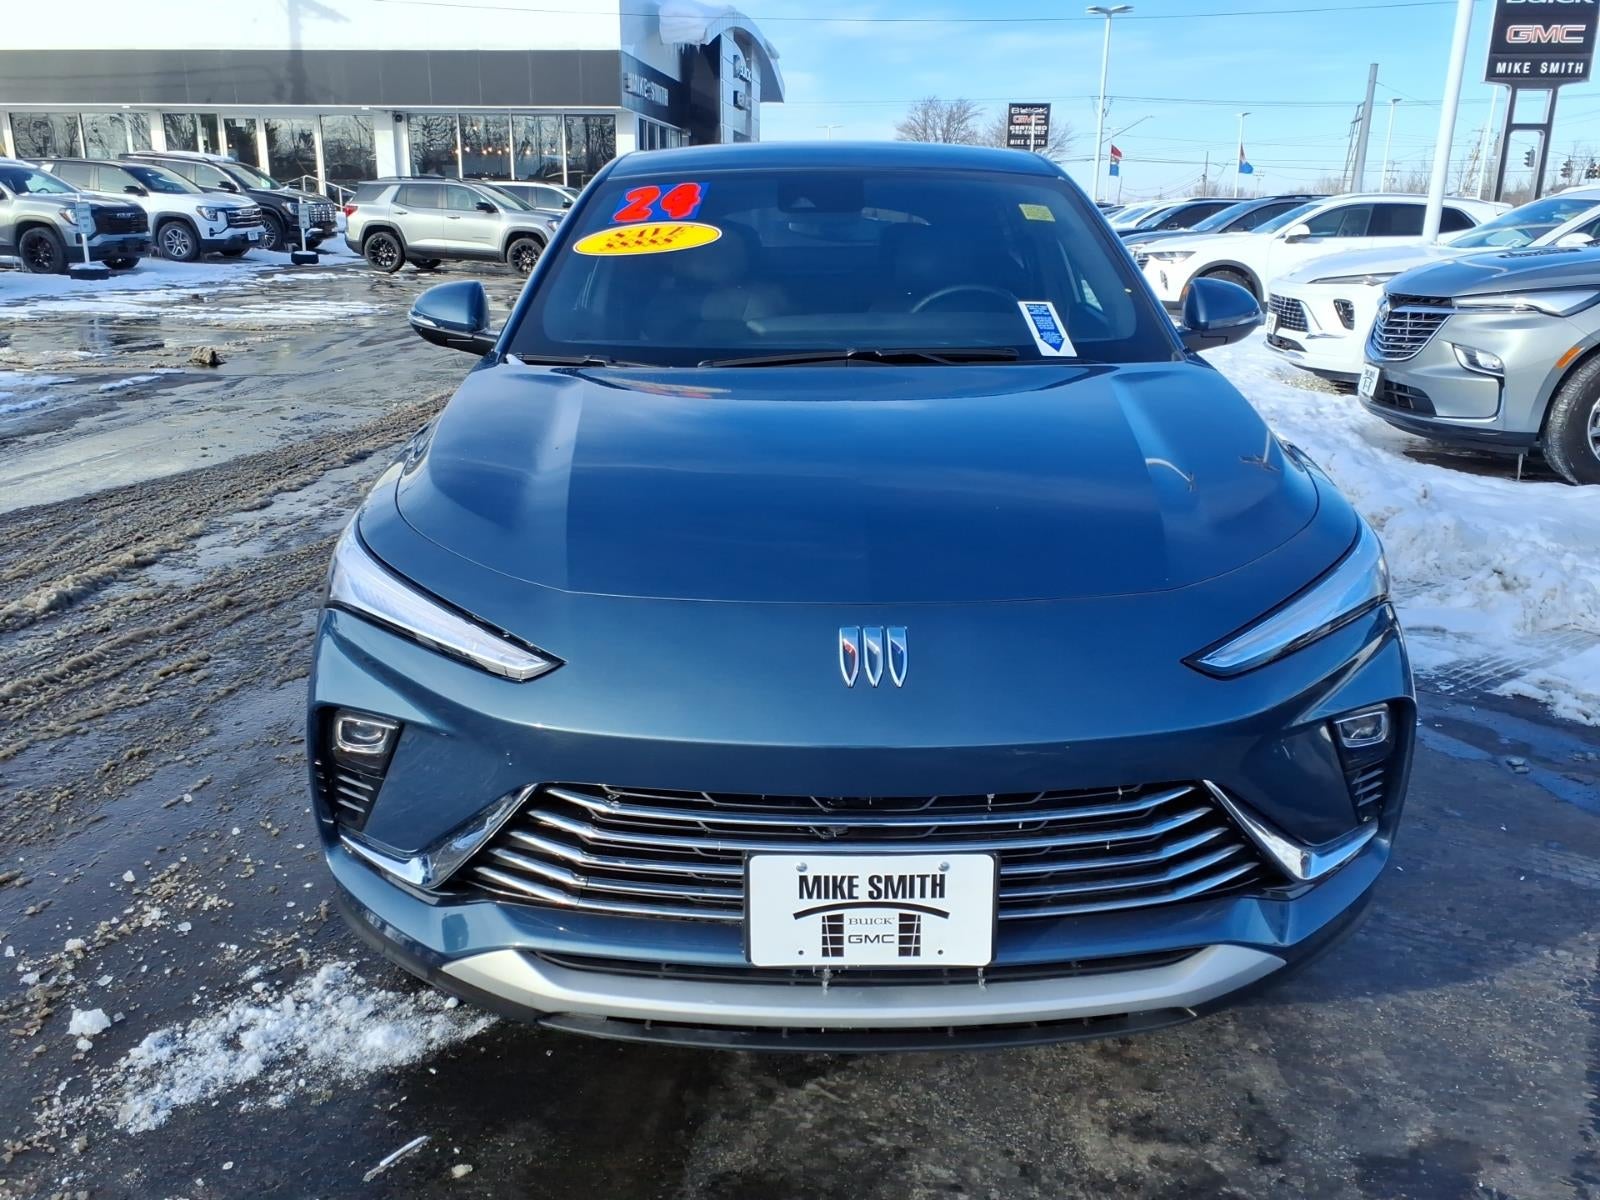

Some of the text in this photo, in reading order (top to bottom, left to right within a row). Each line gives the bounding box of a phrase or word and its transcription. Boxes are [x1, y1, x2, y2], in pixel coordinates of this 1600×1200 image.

[1506, 24, 1586, 43] GMC
[1496, 62, 1584, 74] MIKE SMITH
[613, 182, 702, 222] 24
[799, 874, 946, 900] MIKE SMITH
[848, 934, 895, 943] GMC
